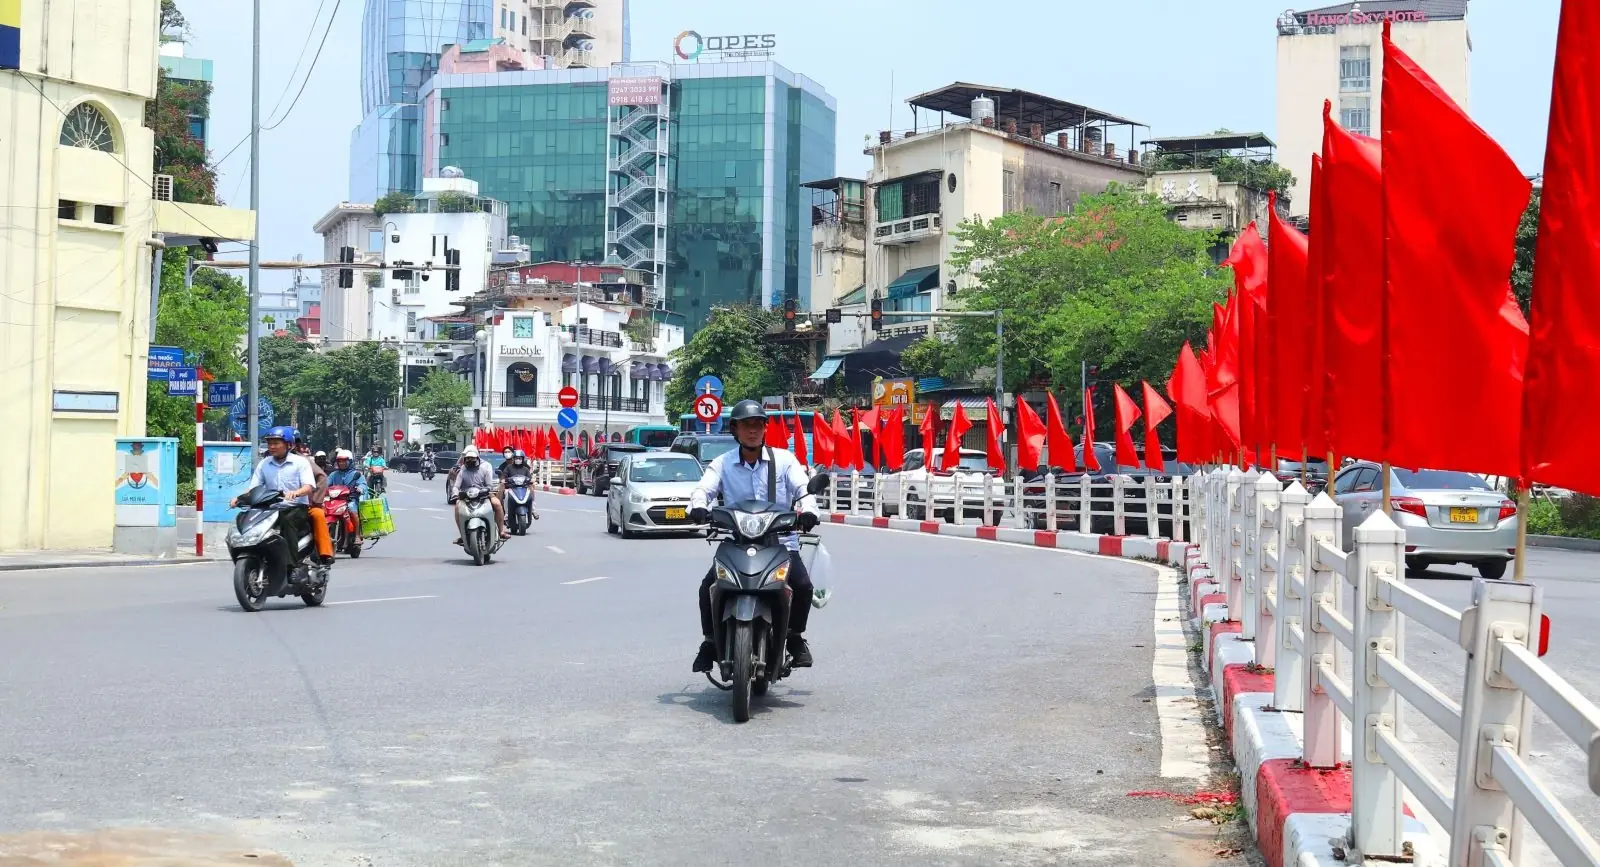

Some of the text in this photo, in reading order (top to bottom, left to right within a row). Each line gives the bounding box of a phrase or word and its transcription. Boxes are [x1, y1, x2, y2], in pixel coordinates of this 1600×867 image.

[1307, 9, 1428, 25] HANOI SKY HOTEL
[707, 34, 776, 50] OPES
[500, 344, 542, 357] EuroStyle
[170, 380, 179, 390] PHAN
[187, 379, 196, 390] CHÂU
[222, 394, 234, 402] NAM
